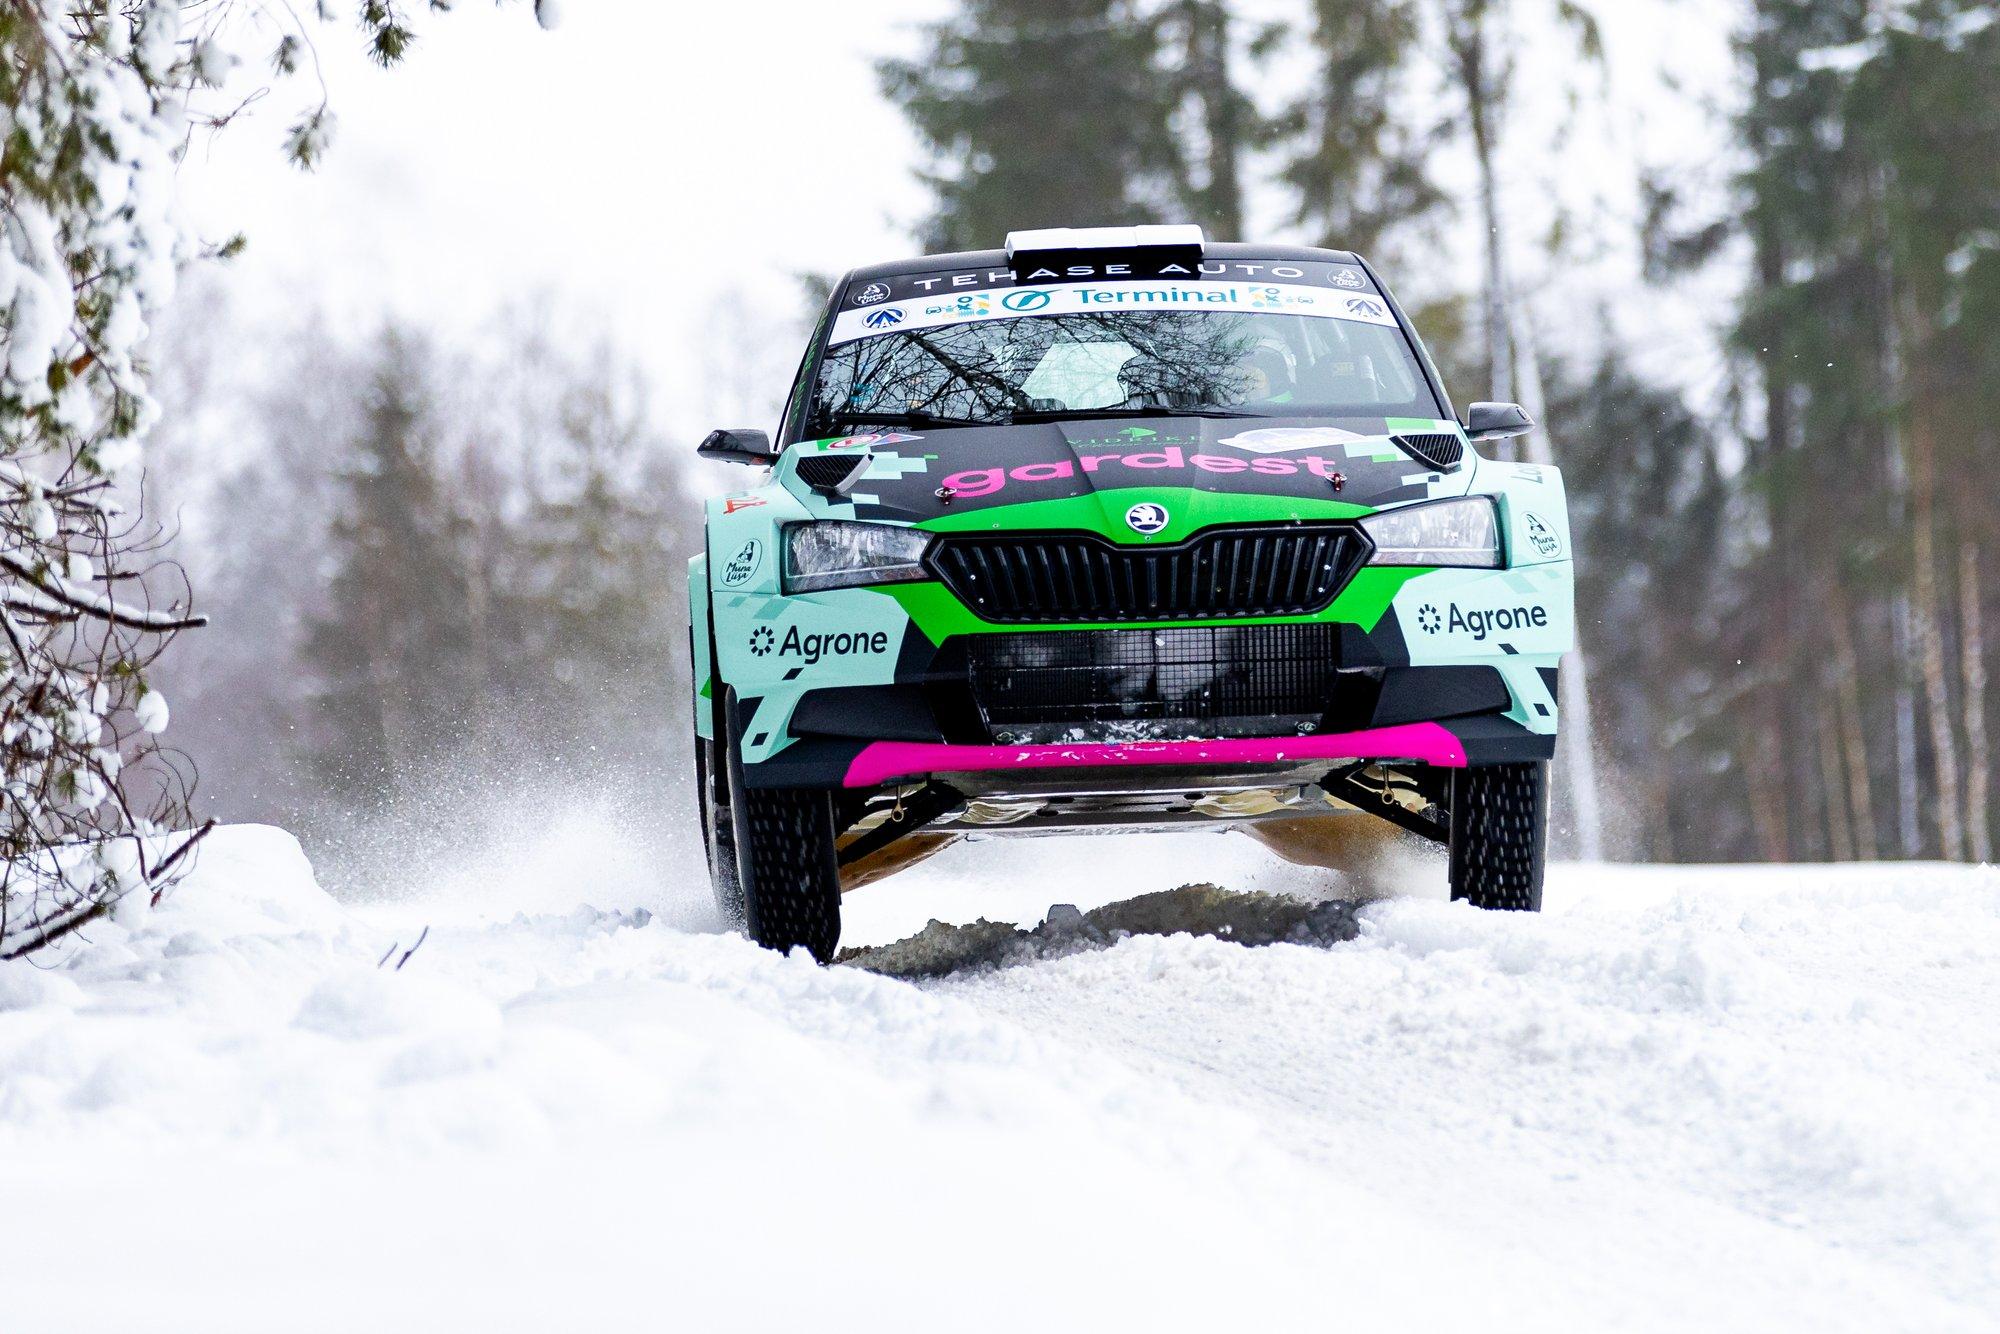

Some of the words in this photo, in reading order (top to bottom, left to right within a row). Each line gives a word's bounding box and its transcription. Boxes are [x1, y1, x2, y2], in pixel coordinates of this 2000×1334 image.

[913, 264, 1132, 290] TEHASE
[1158, 263, 1304, 278] AUTO
[1072, 287, 1238, 304] Terminal
[941, 446, 1338, 498] gardest
[1529, 535, 1556, 546] Muna
[726, 562, 752, 573] Muna
[1448, 602, 1548, 641] Agrone
[778, 624, 888, 665] Agrone
